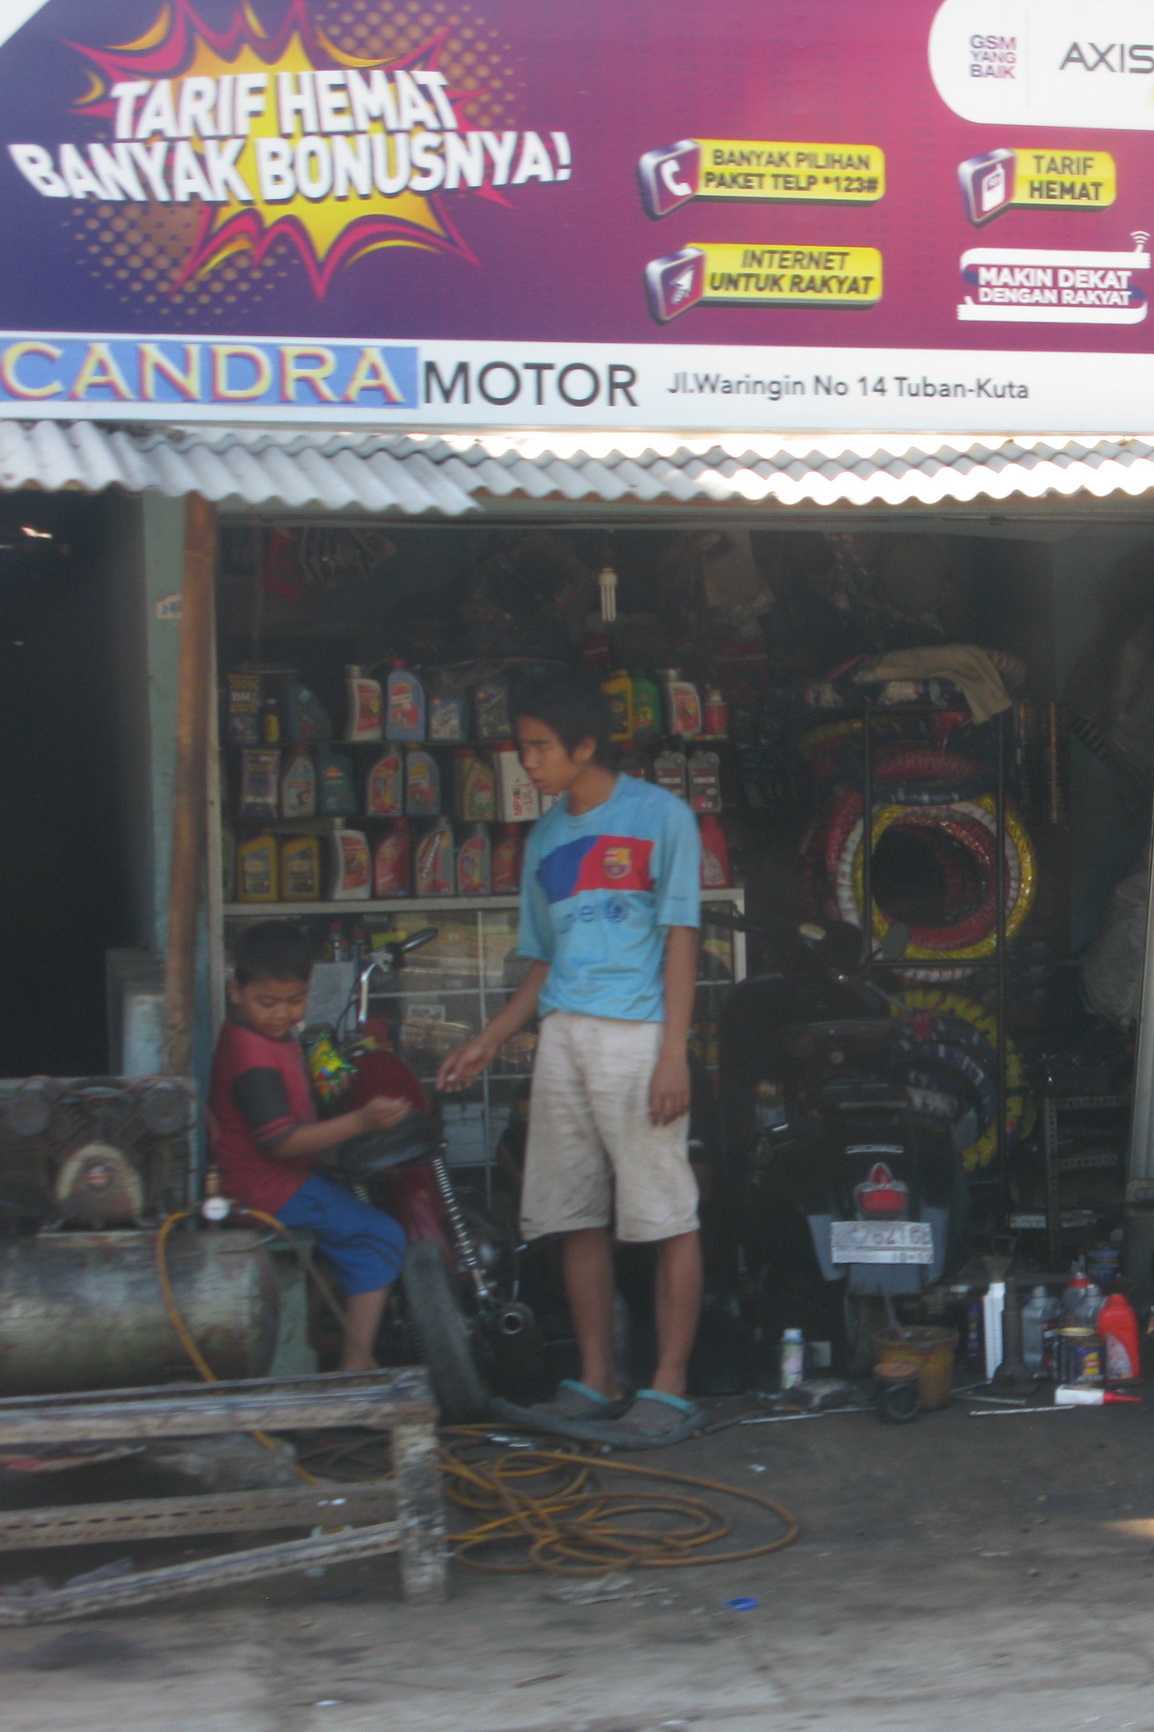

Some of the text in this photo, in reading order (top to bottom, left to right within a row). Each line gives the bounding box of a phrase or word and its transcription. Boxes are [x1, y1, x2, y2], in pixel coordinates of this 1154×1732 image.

[969, 34, 1017, 50] GSM
[970, 49, 1017, 65] YANG
[969, 64, 1016, 80] BAIK
[110, 69, 459, 139] TARIF HEMAT
[8, 131, 573, 203] BANYAK BONUSNYA!
[712, 148, 871, 171] BANYAK PILIHAN
[1032, 155, 1095, 174] TARIF
[704, 171, 767, 191] PAKET
[771, 173, 818, 192] TELP
[1028, 180, 1104, 201] HEMAT
[741, 250, 849, 271] INTERNET
[709, 272, 875, 296] UNTUK RAKYAT
[978, 267, 1133, 291] MAKIN DEKAT
[979, 288, 1133, 306] DENGAN RAKYAT
[0, 340, 639, 408] CANDRA MOTOR
[813, 375, 849, 397] No
[857, 376, 887, 397] 14
[895, 376, 1030, 400] Tuban-Kuta
